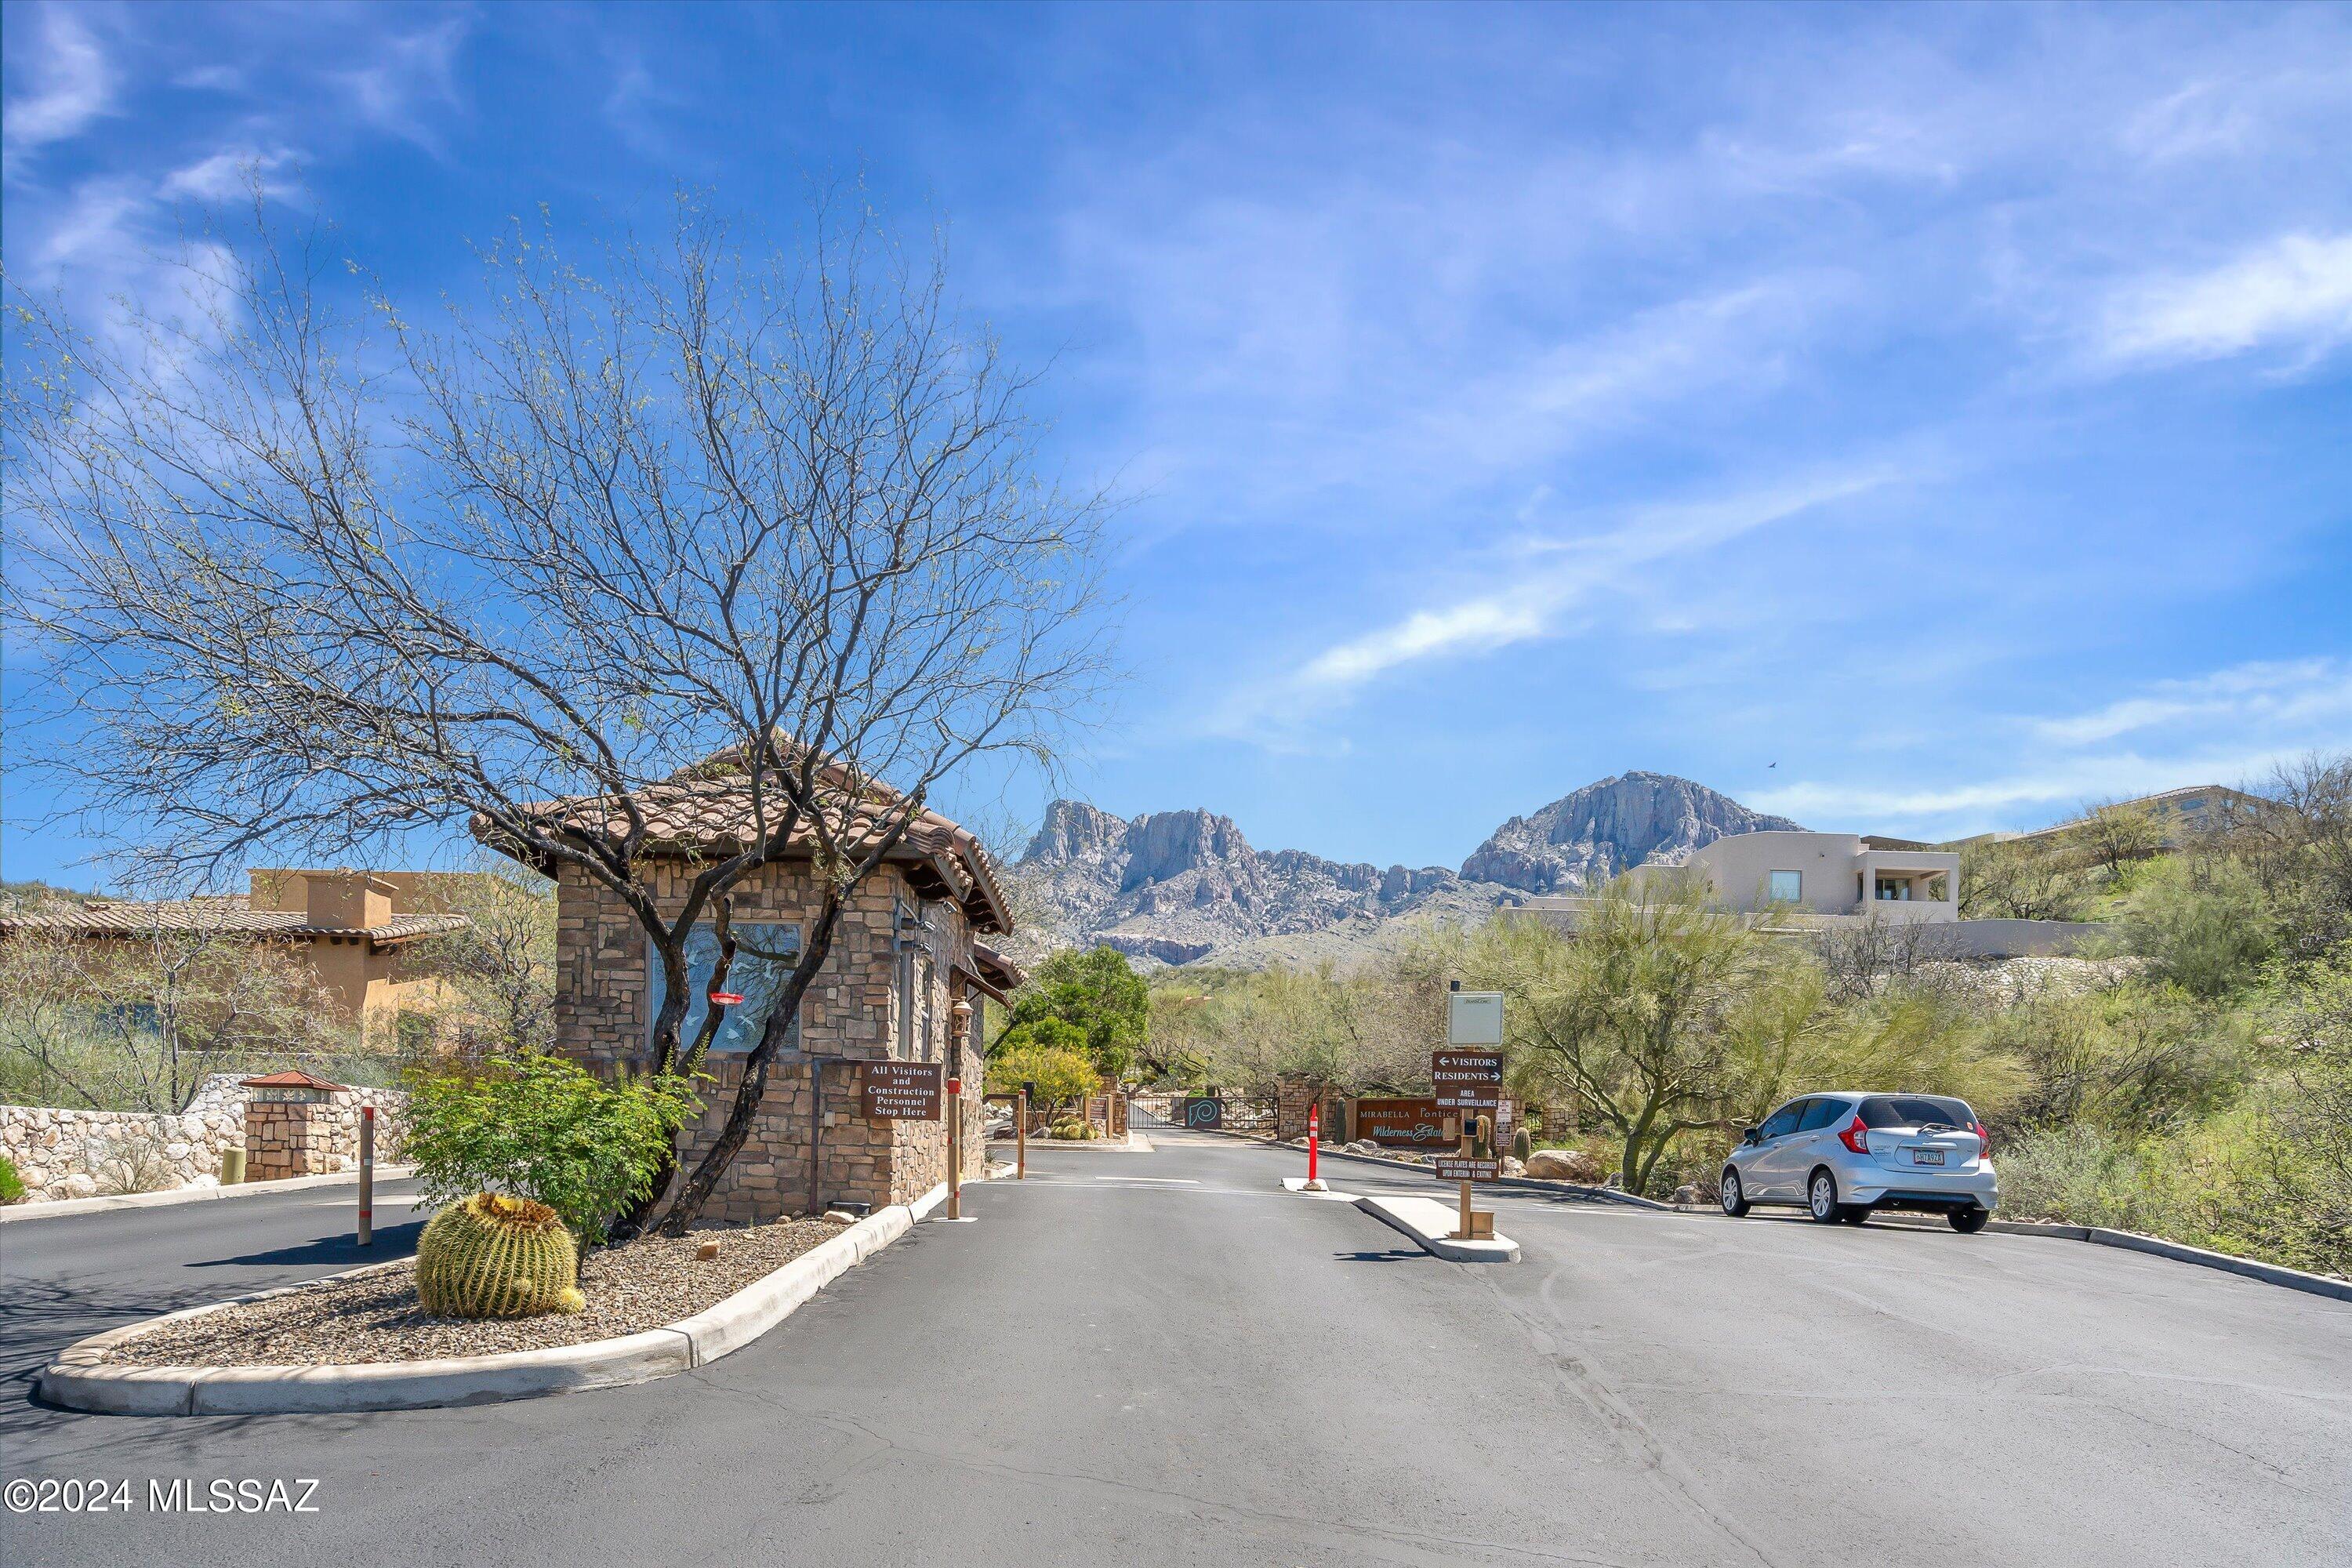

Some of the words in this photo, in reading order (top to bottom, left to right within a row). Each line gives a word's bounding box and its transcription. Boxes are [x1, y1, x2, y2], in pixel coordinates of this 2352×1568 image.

[1452, 1058, 1497, 1066] VISITORS
[892, 1066, 933, 1076] Visitors
[1434, 1071, 1489, 1080] RESIDENTS
[868, 1086, 935, 1096] Construction
[877, 1096, 926, 1106] Personnel
[1457, 1098, 1497, 1107] SURVEILLANCE
[875, 1107, 898, 1116] Stop
[902, 1107, 927, 1116] Here
[1420, 1107, 1462, 1118] Ponticel
[1373, 1125, 1413, 1137] Wilderness
[1412, 1123, 1443, 1142] Estat
